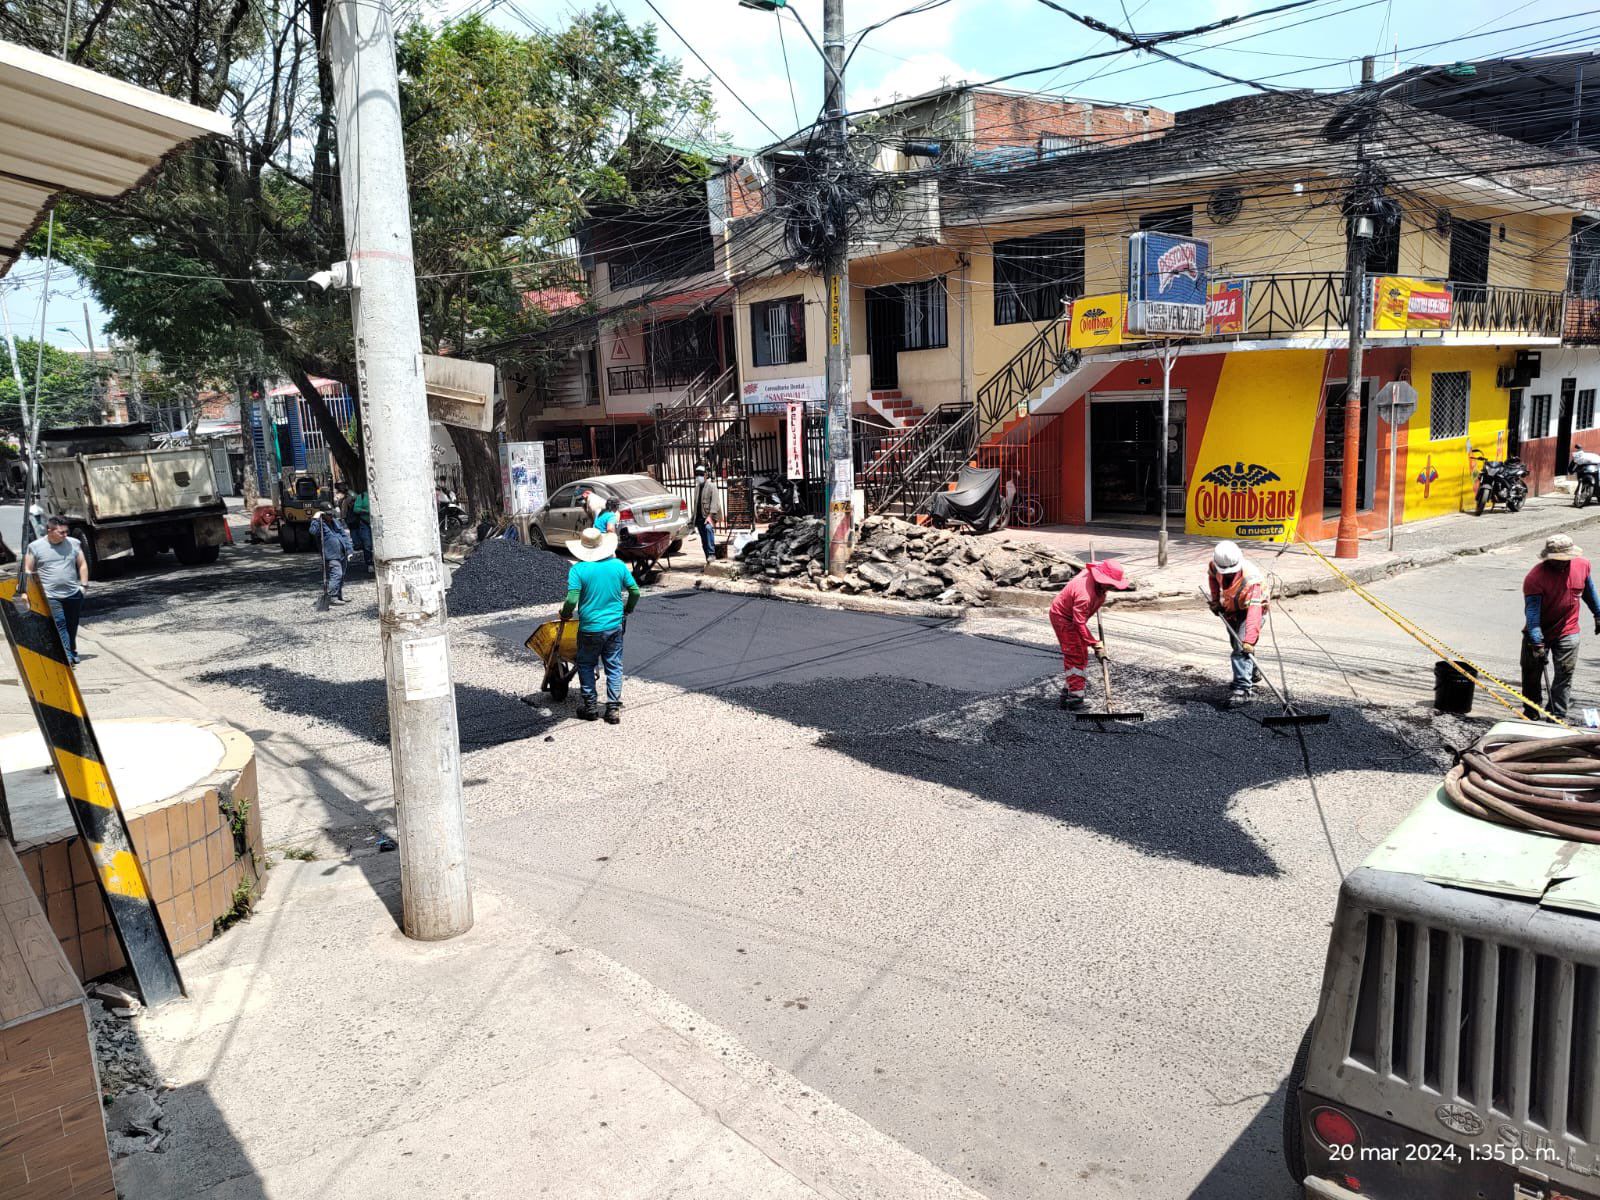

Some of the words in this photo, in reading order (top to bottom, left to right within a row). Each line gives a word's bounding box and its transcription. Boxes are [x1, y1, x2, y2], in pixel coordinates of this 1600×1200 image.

[1080, 317, 1113, 334] Colombiana
[1195, 485, 1296, 528] Colombiana
[1248, 526, 1284, 535] nuestra
